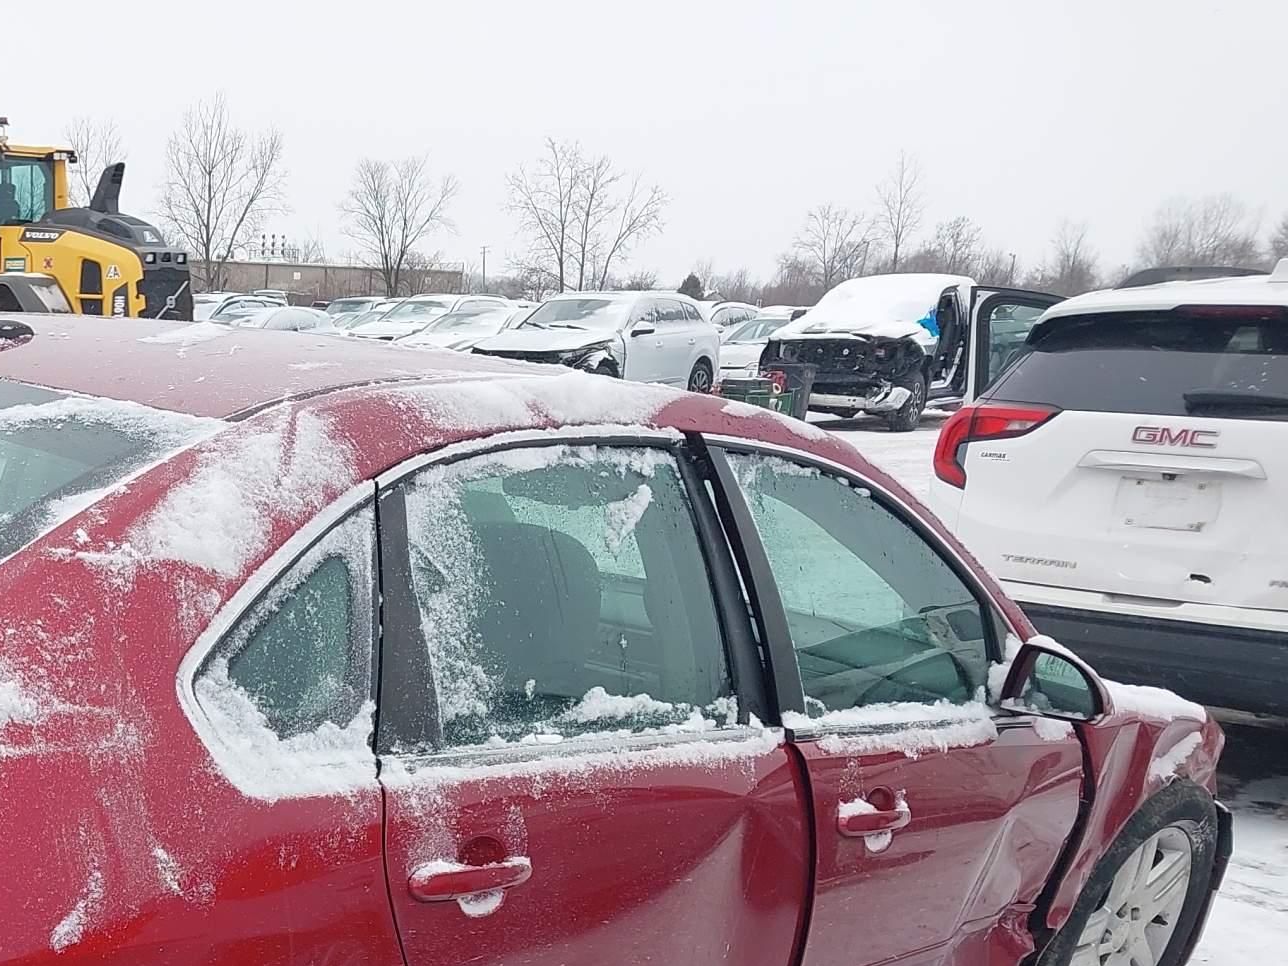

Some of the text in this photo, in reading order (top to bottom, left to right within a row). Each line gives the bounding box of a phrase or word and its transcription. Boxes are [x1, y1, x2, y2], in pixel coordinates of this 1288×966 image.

[24, 231, 60, 239] VOLVO
[1132, 426, 1219, 449] GMC
[1001, 553, 1078, 569] TERRAIN
